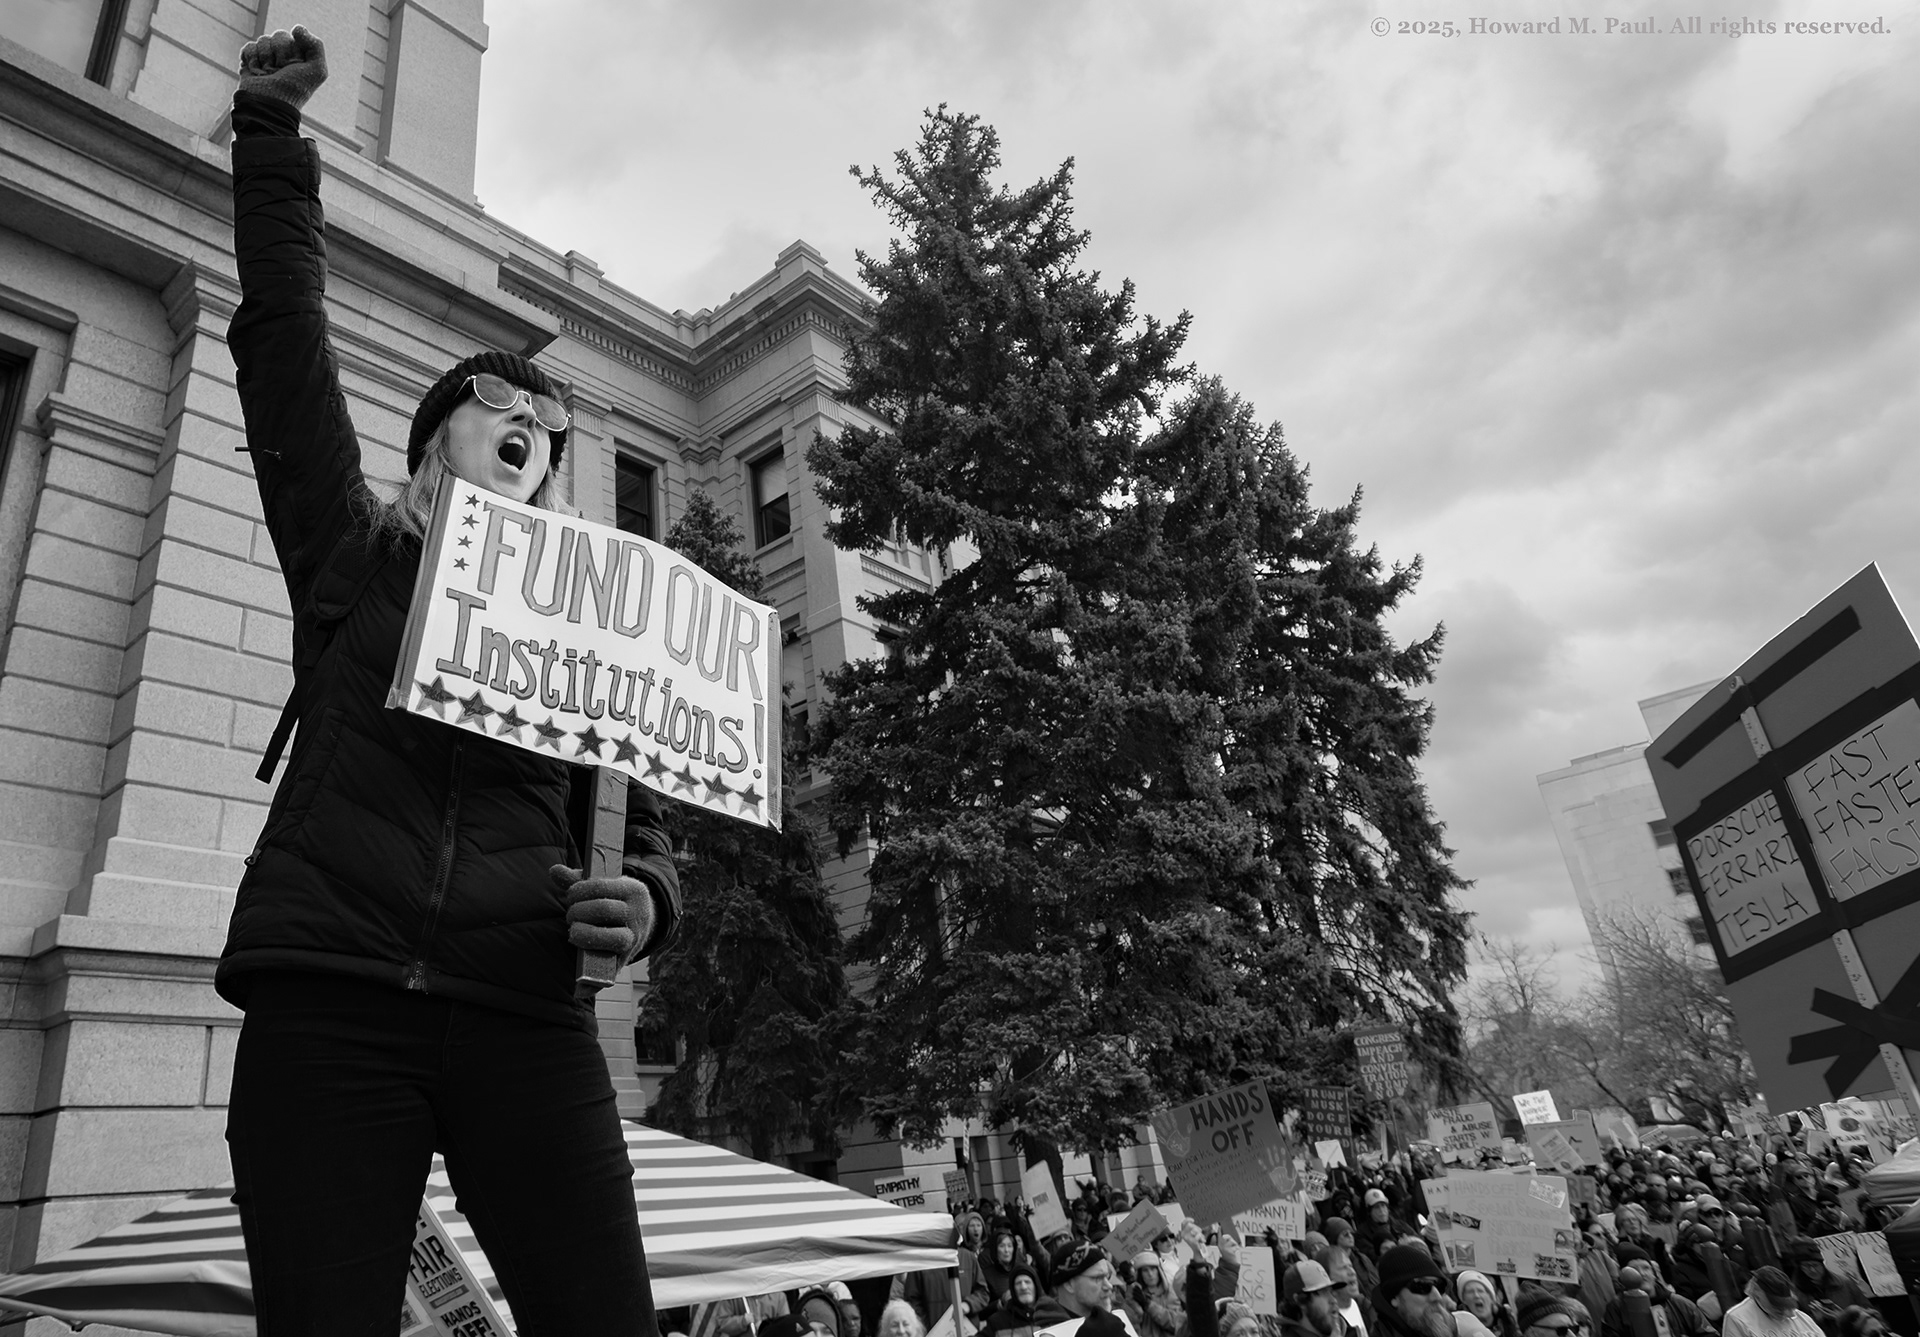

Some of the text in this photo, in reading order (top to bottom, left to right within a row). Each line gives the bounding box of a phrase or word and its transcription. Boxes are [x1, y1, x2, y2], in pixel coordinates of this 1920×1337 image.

[477, 500, 764, 701] FUND OUR
[435, 587, 765, 780] Institutions!
[1803, 724, 1889, 801] FAST
[1813, 760, 1920, 843] FASTE
[1689, 792, 1783, 869] PORSCHE
[1700, 832, 1798, 908] FERRARI
[1716, 882, 1808, 947] TESLA
[1354, 1033, 1400, 1046] CONGRESS
[1357, 1043, 1403, 1056] IMPEACH
[1370, 1053, 1394, 1063] AND
[1360, 1061, 1404, 1074] CONVICT
[1362, 1070, 1408, 1083] TRAITOR
[1364, 1079, 1409, 1092] TRUMP
[1303, 1088, 1344, 1101] TRUMP
[1189, 1085, 1264, 1131] HANDS
[1310, 1099, 1344, 1112] MUSK
[1306, 1111, 1347, 1124] DOGE
[1443, 1113, 1474, 1125] FRAUD
[1307, 1122, 1352, 1136] YOU'RE
[1450, 1120, 1494, 1134] & ABUSE
[1211, 1120, 1254, 1153] OFF
[1443, 1132, 1477, 1144] STARTS
[875, 1176, 920, 1195] EMPATHY
[1454, 1179, 1491, 1196] HANDS
[889, 1193, 925, 1208] ATTERS
[1234, 1220, 1264, 1234] ANDS
[419, 1267, 463, 1299] ELECTIONS
[440, 1300, 481, 1328] HANDS
